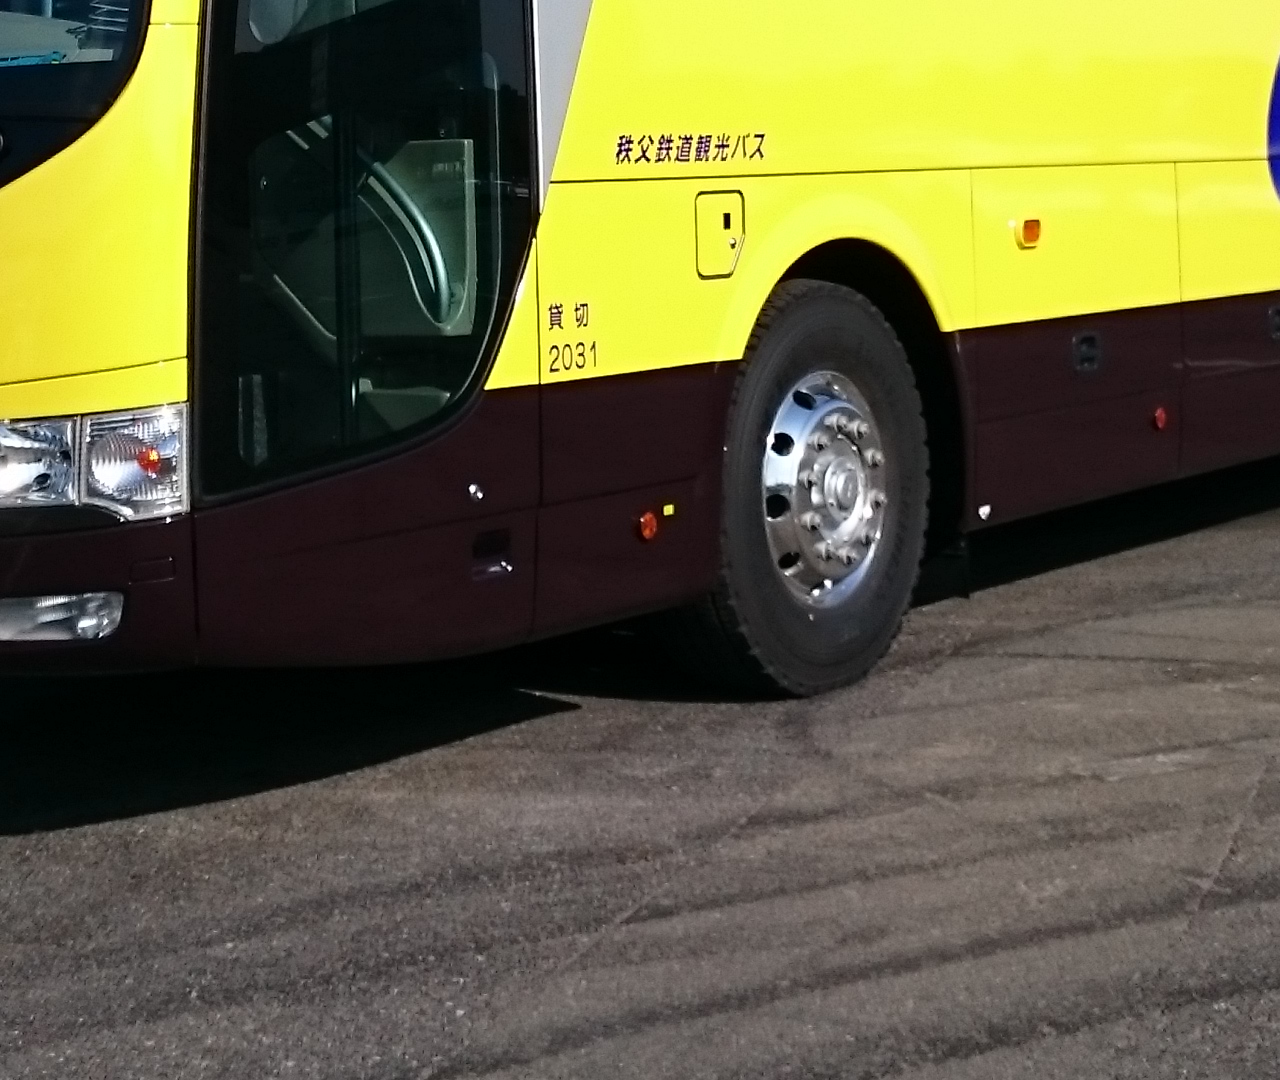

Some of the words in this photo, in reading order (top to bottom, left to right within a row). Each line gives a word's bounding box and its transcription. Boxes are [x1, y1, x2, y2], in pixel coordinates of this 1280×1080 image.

[615, 133, 766, 165] 秩父鉄道観光バス
[548, 341, 597, 373] 2031
